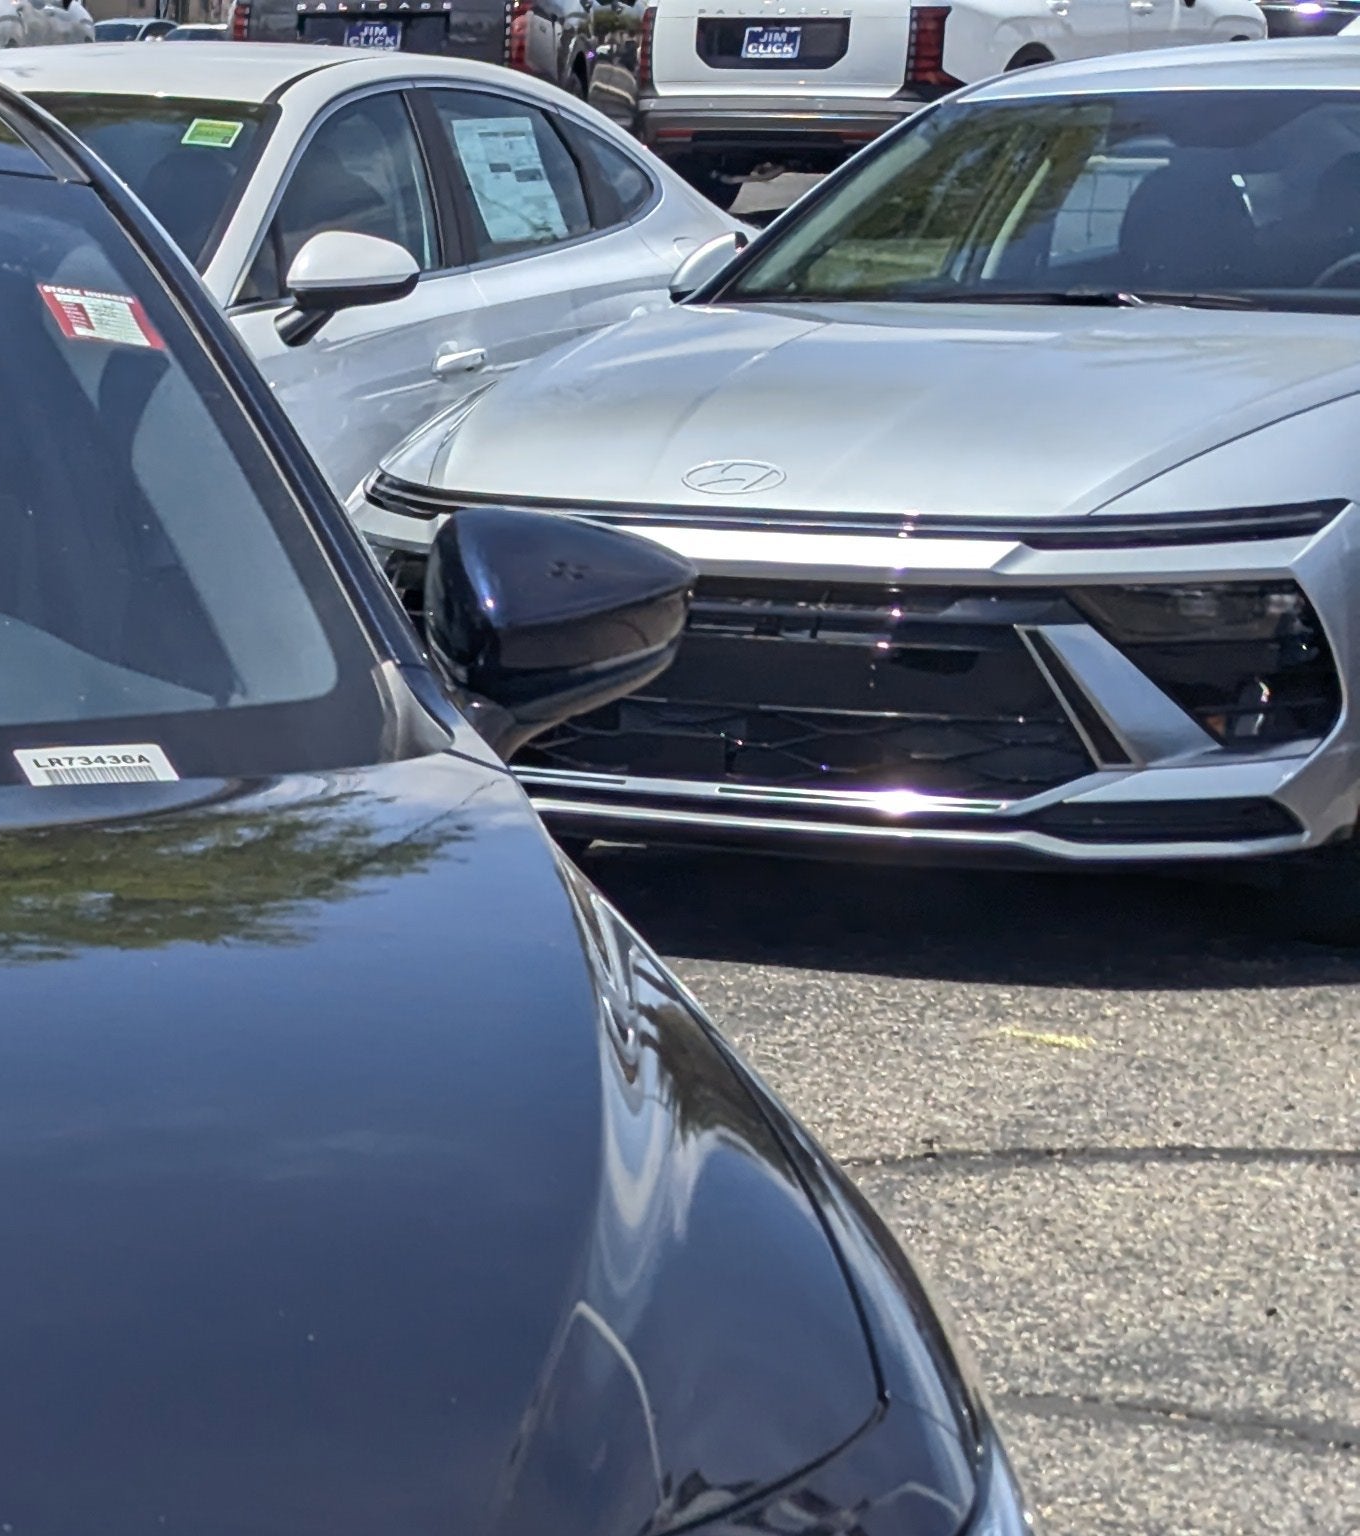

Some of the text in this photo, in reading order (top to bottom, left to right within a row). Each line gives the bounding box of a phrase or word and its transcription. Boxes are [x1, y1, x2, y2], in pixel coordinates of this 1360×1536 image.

[359, 26, 388, 37] JIM
[758, 32, 788, 42] JIM
[348, 36, 396, 47] CLICK
[747, 42, 794, 54] CLICK
[42, 284, 135, 304] STOCK NUMBER
